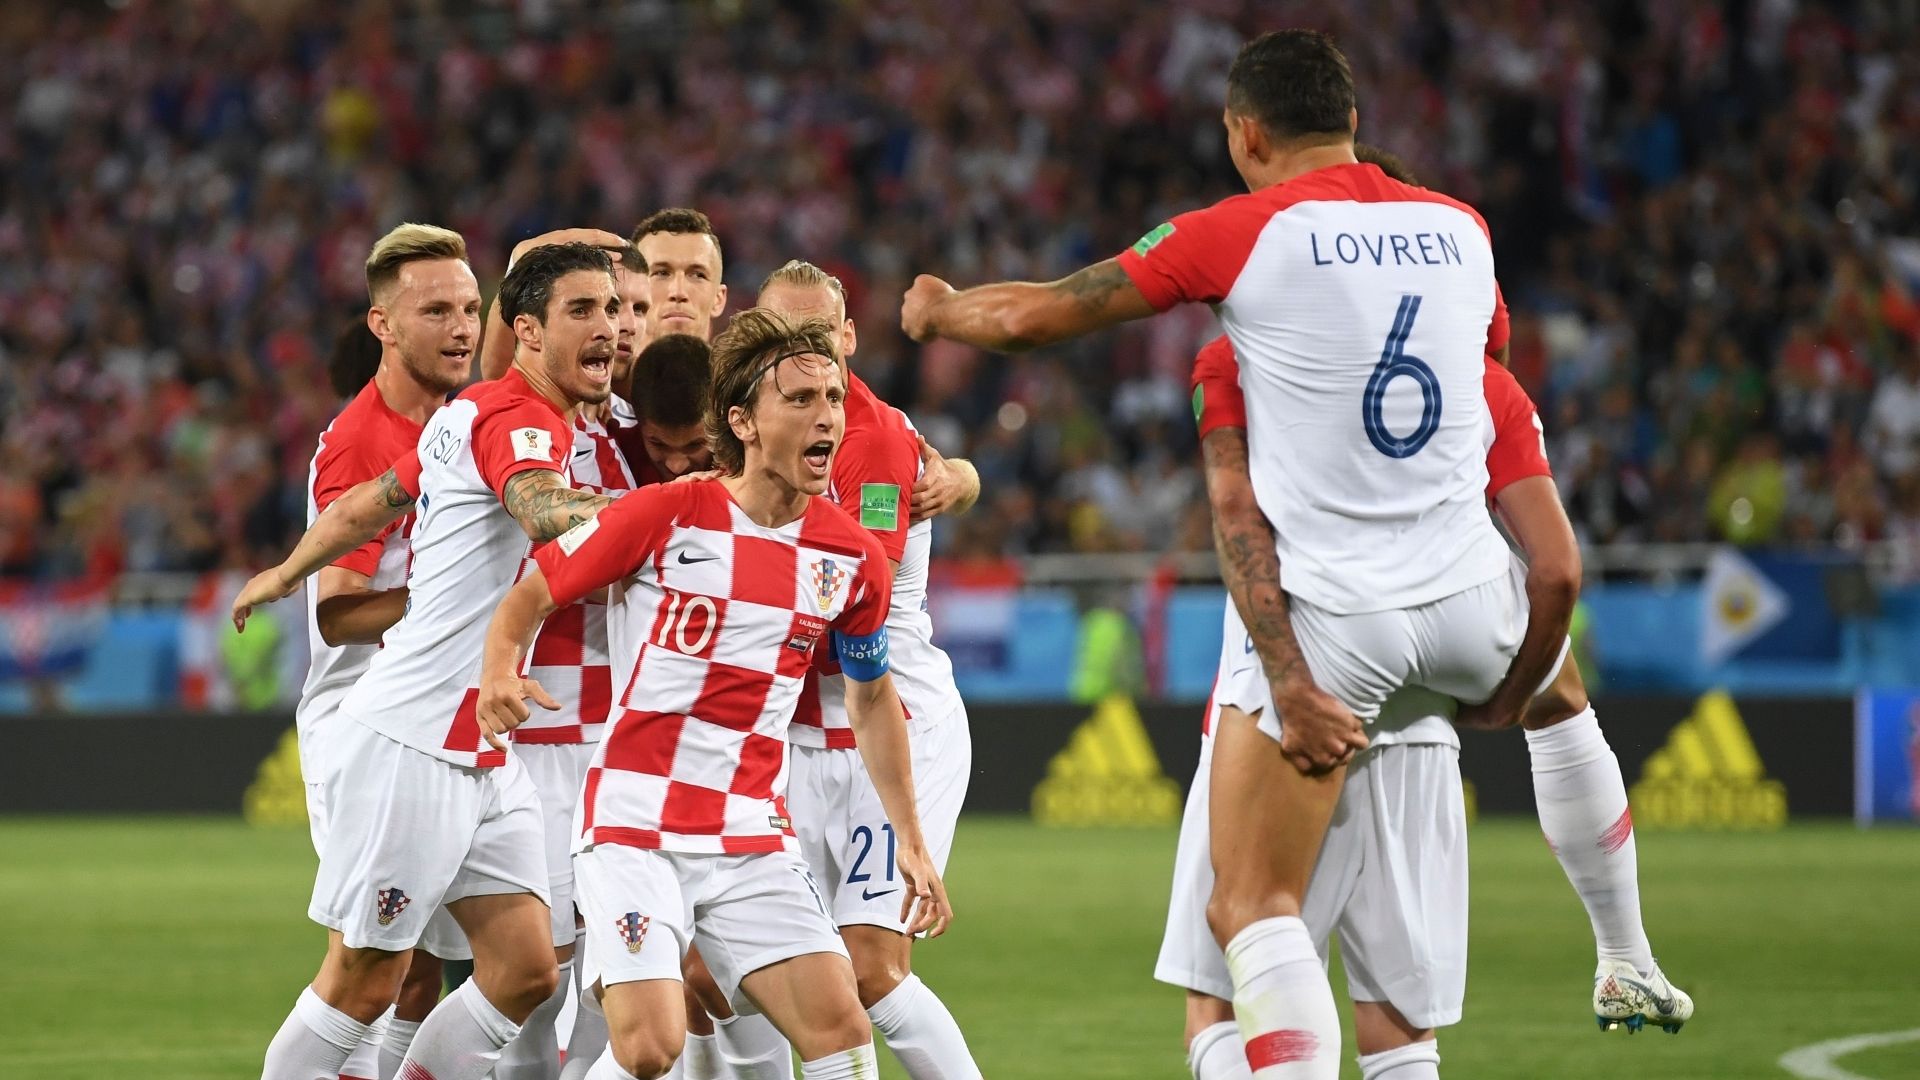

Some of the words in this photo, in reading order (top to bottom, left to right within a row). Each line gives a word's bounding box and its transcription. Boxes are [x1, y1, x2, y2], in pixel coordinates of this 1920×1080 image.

[1311, 232, 1462, 265] LOVREN
[1362, 294, 1443, 459] 6
[657, 589, 717, 655] 10
[845, 823, 896, 885] 21
